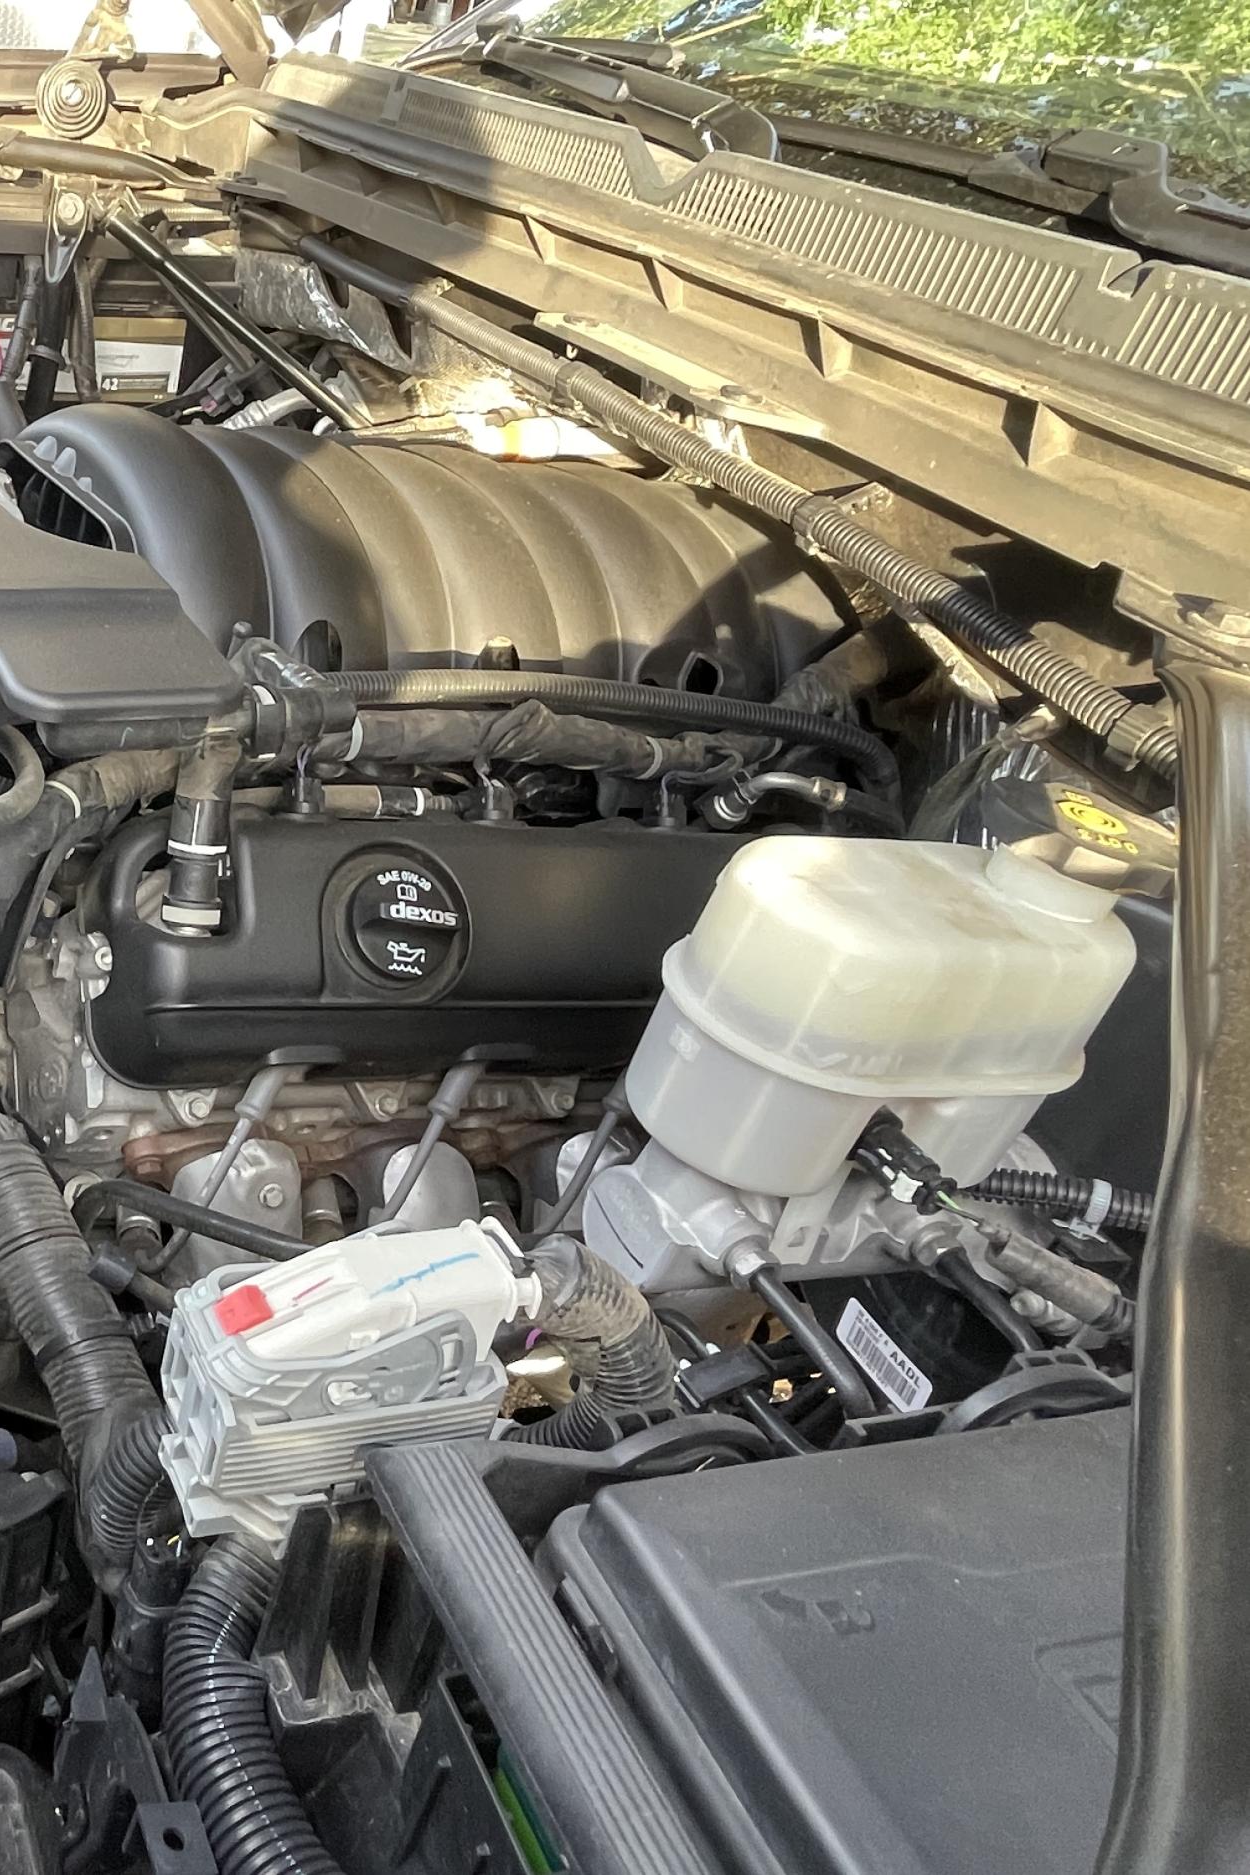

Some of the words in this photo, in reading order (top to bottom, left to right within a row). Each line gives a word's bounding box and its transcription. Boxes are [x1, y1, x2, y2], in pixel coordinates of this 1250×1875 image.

[102, 378, 119, 390] 42
[376, 870, 400, 886] SAE
[389, 901, 459, 926] dexos
[890, 1350, 920, 1389] AADL
